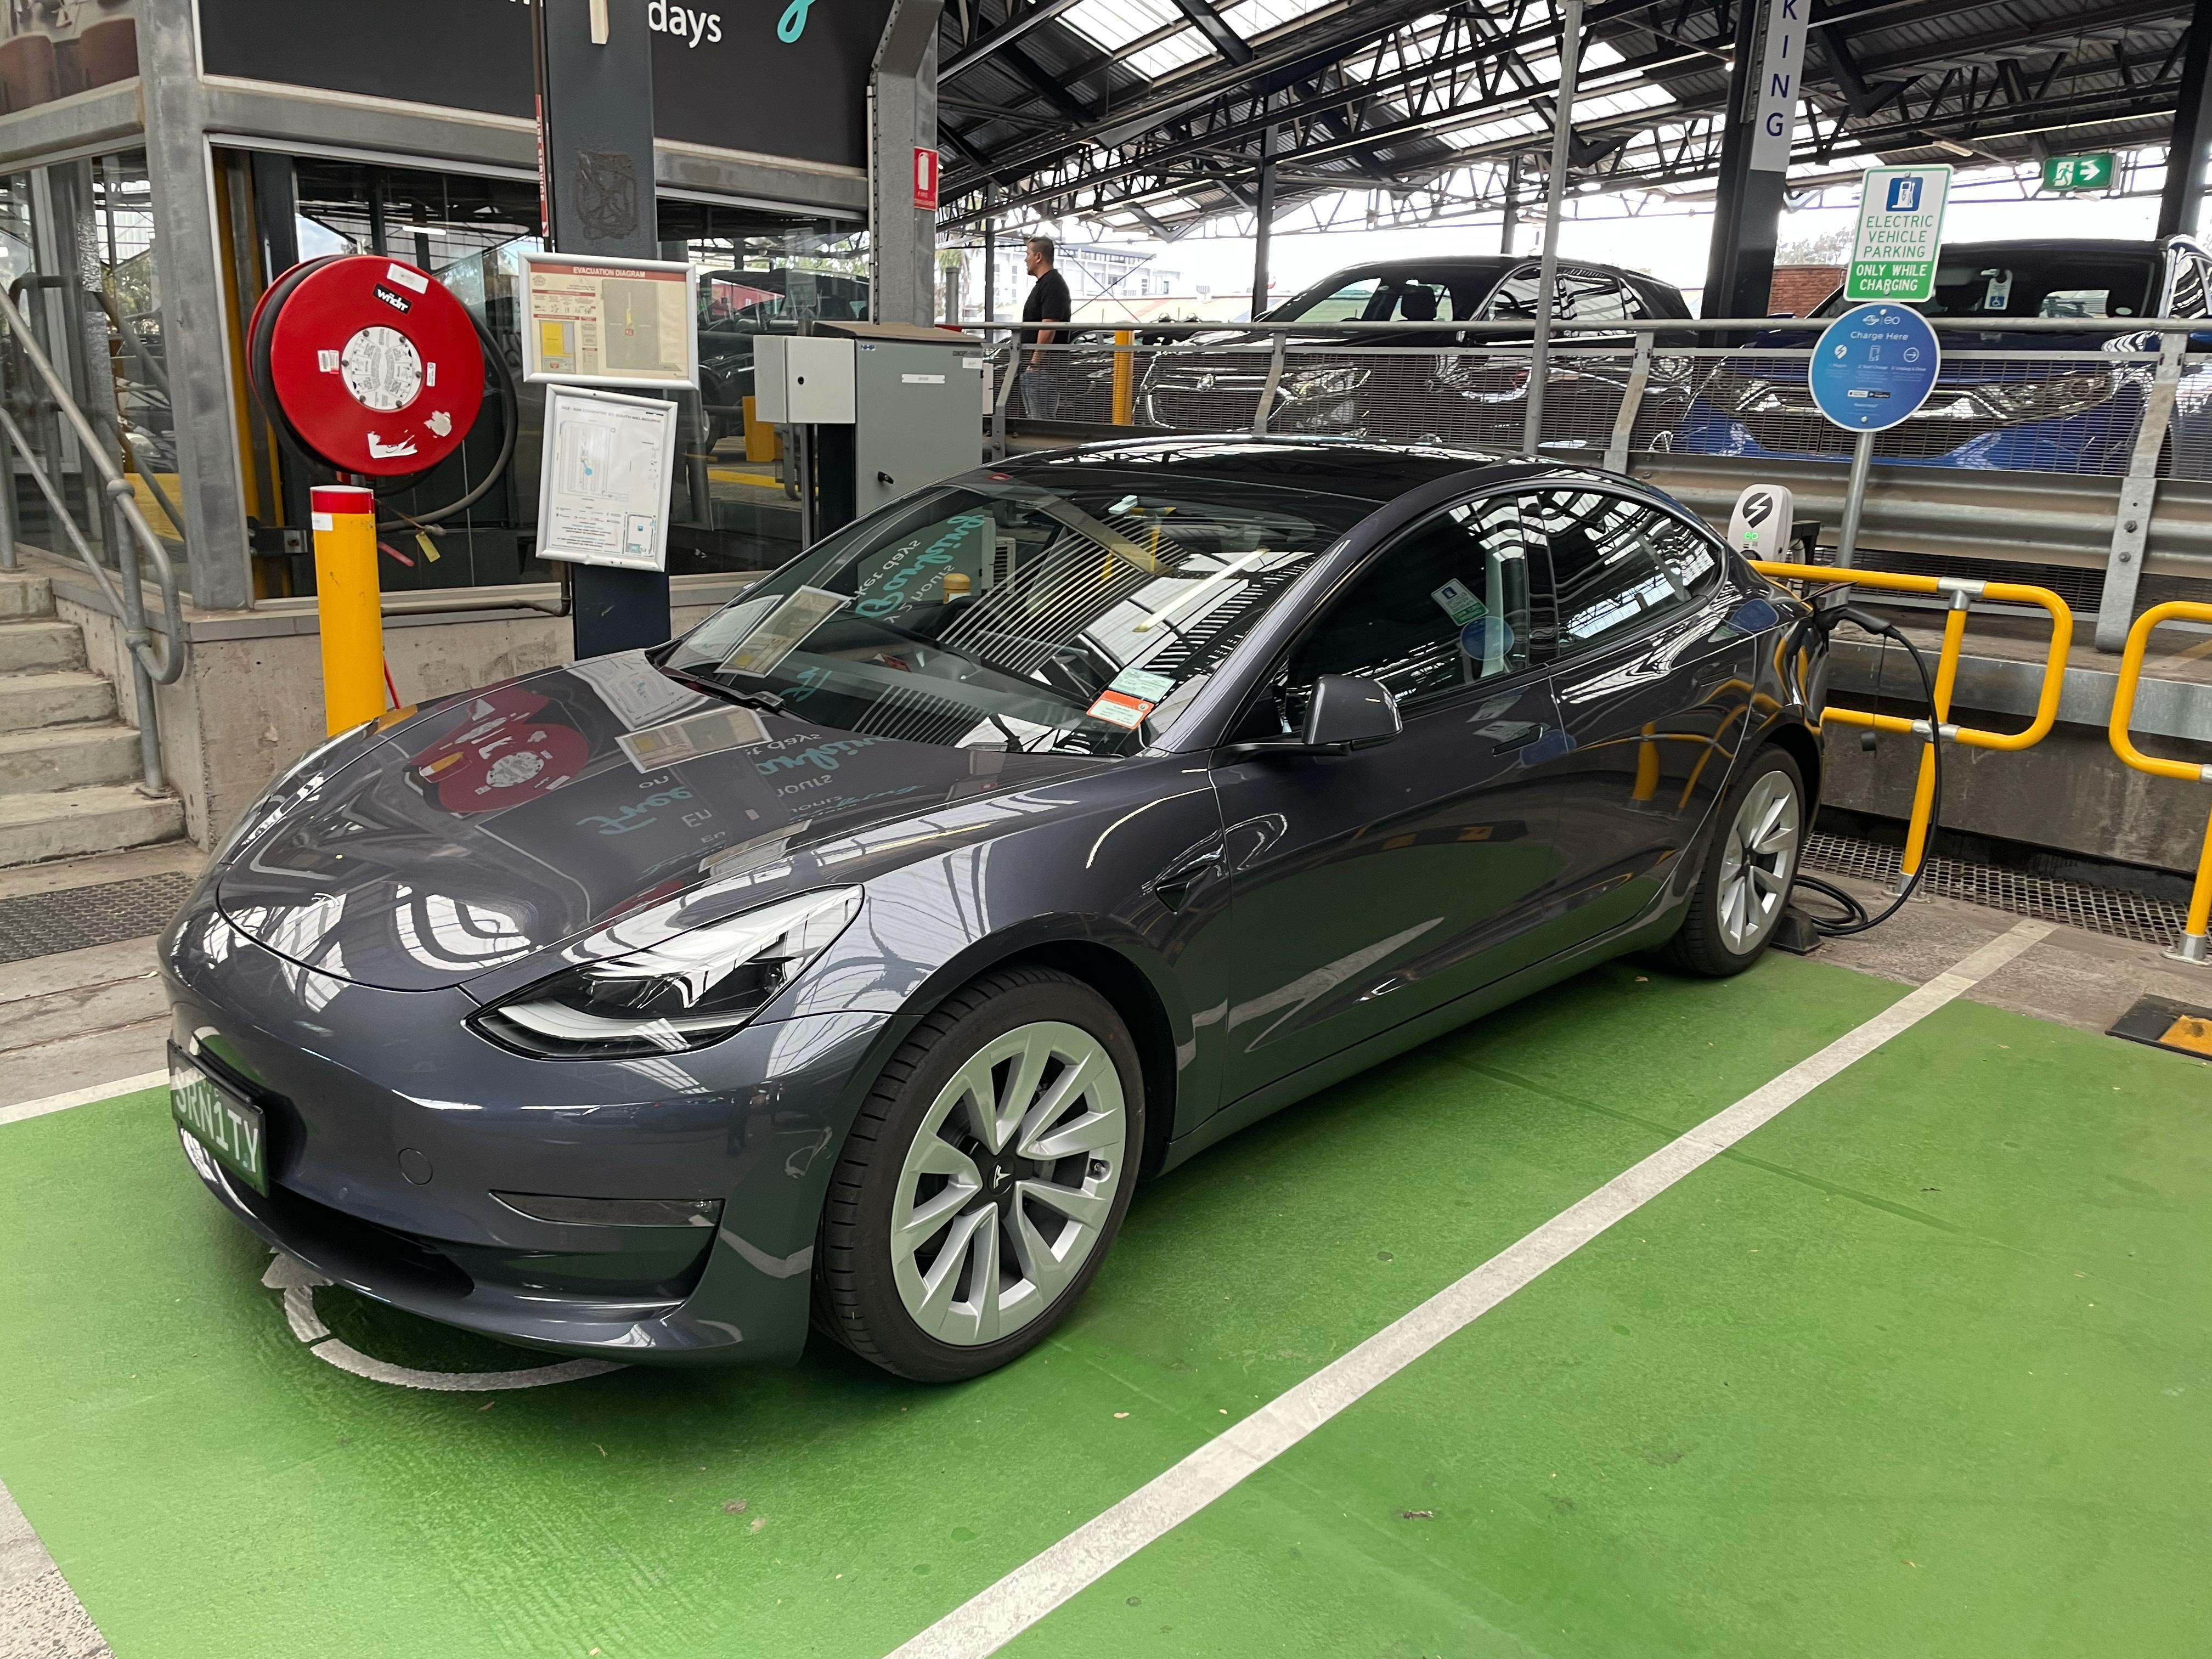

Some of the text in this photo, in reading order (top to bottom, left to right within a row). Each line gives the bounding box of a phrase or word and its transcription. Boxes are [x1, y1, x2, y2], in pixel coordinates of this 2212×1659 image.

[648, 0, 722, 48] days
[1866, 215, 1933, 228] ELECTRIC
[1869, 230, 1927, 242] VEHICLE
[1864, 246, 1925, 258] PARKING
[573, 267, 646, 278] EVACUATION DIAGRAM
[1856, 264, 1928, 276] ONLY WHILE
[1860, 279, 1918, 291] CHARGING
[1850, 331, 1909, 341] Charge Here
[175, 1066, 258, 1173] SRN1TY
